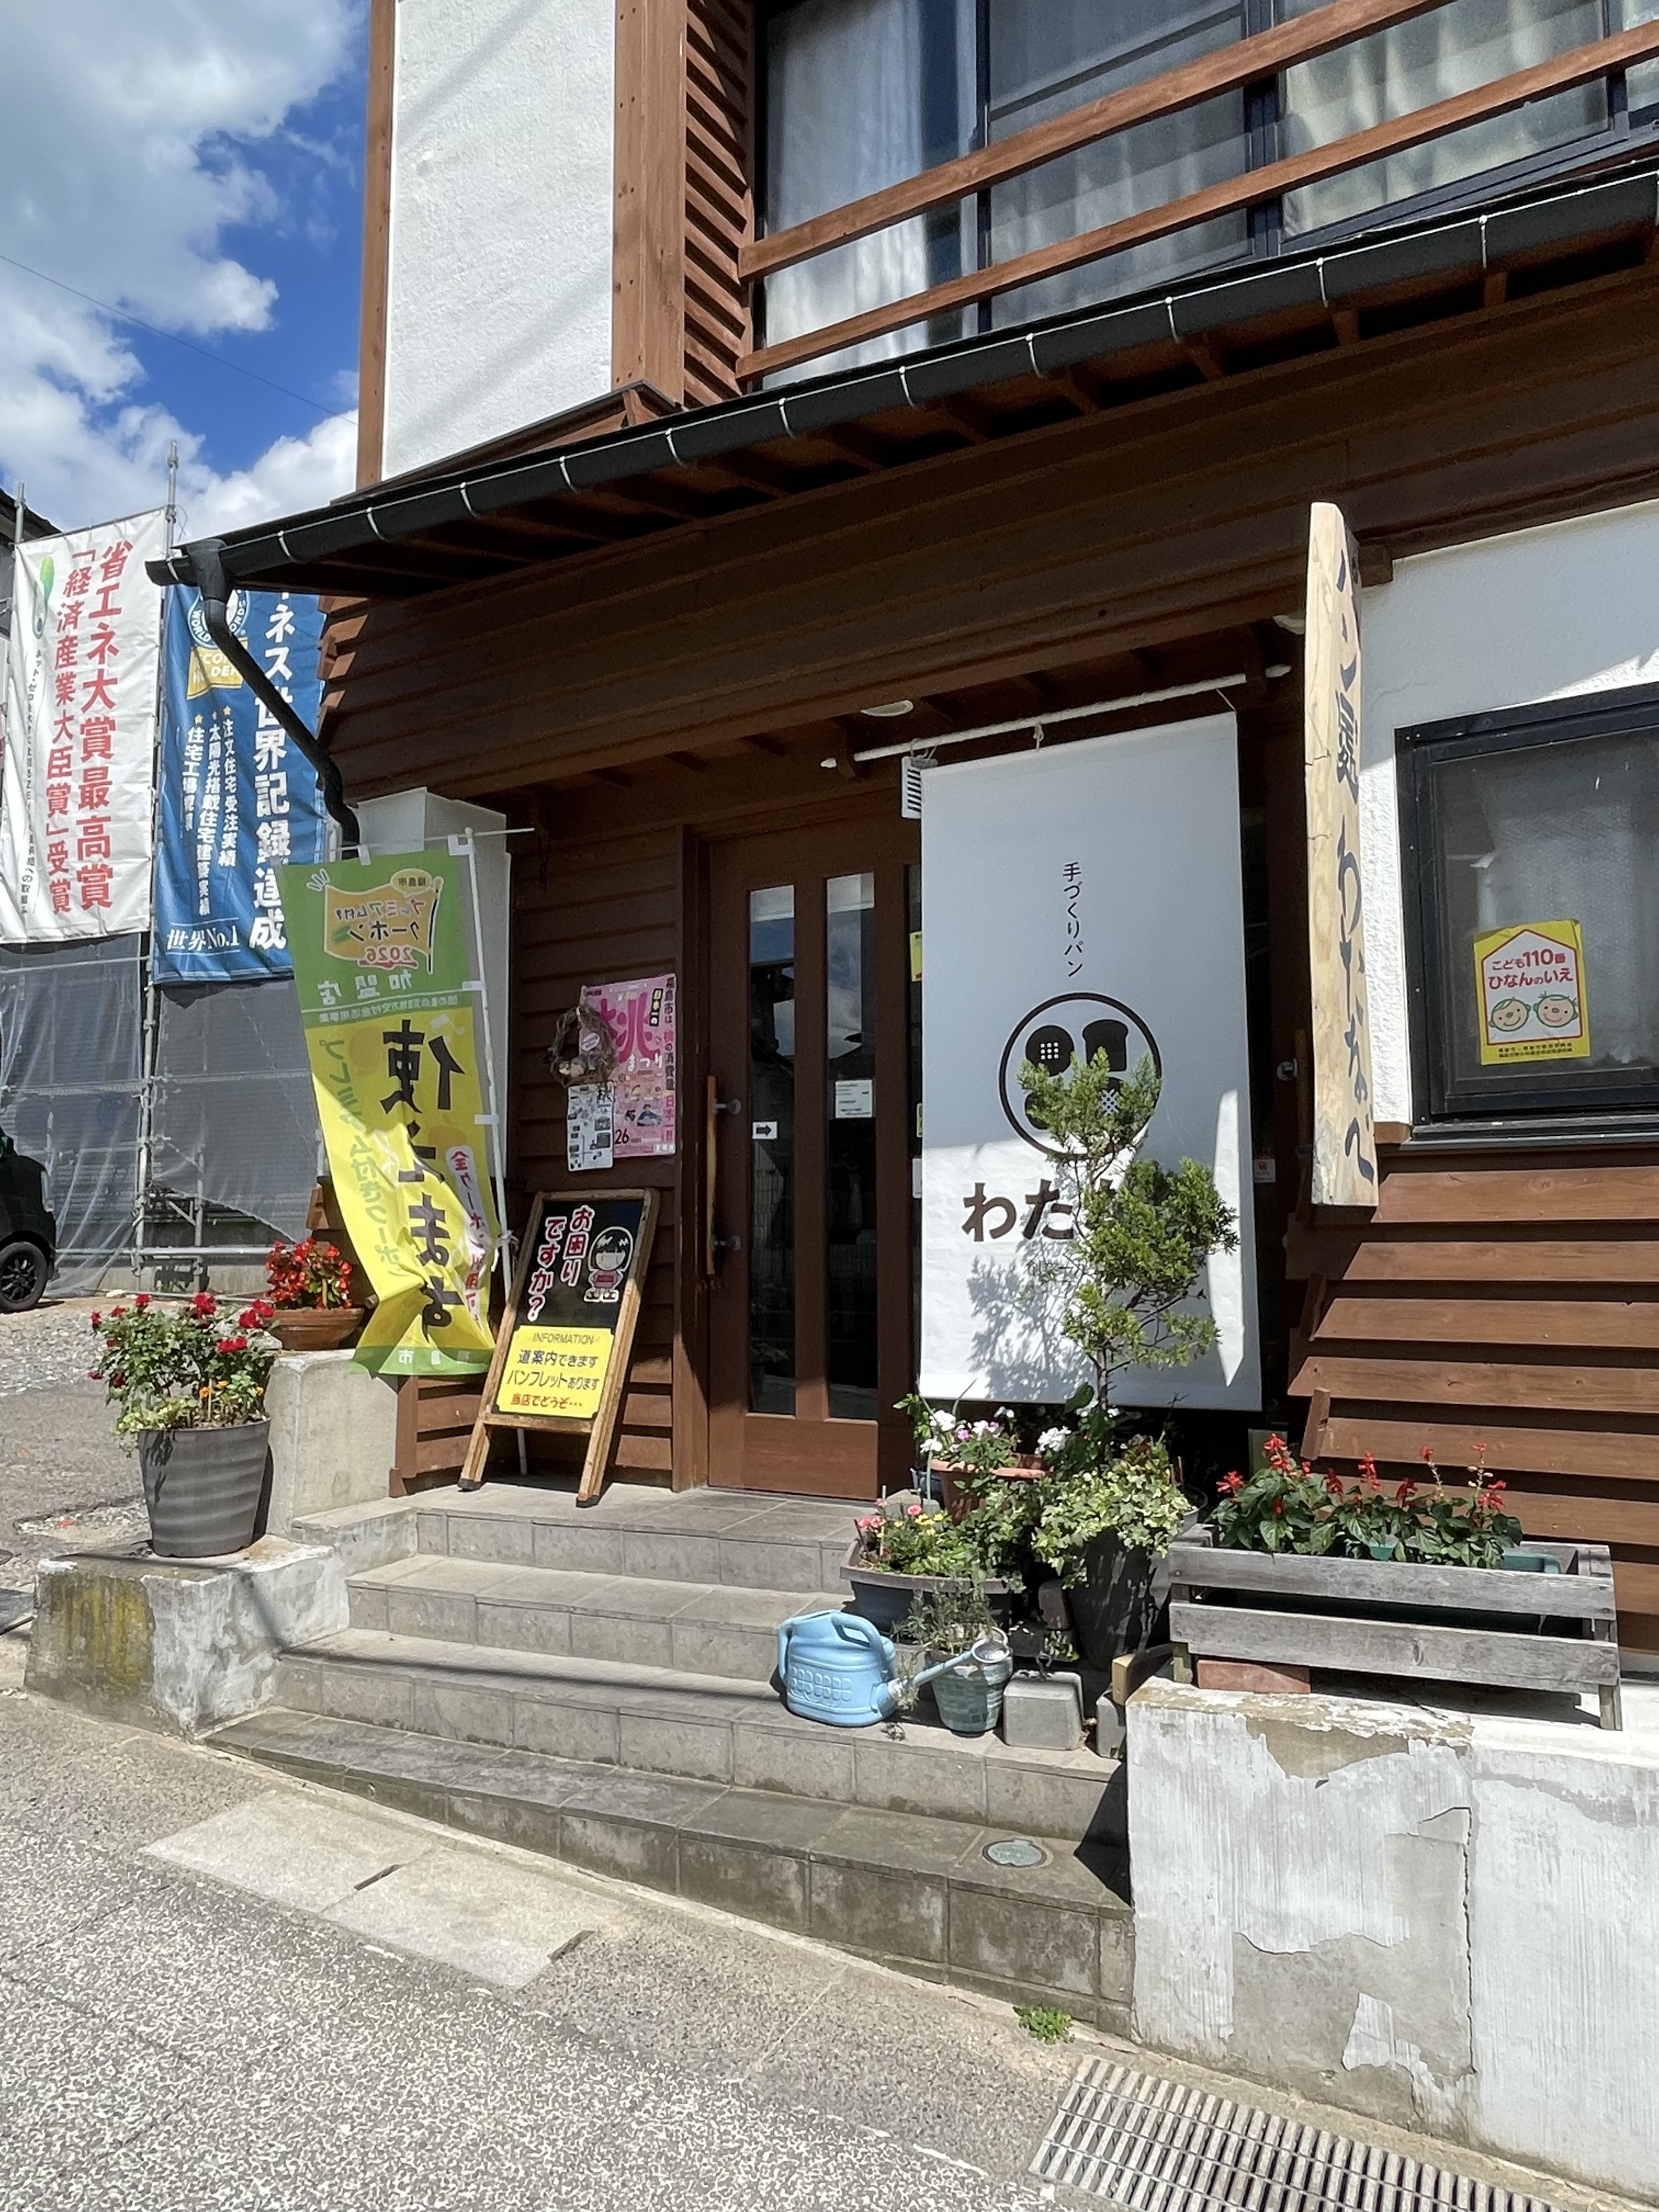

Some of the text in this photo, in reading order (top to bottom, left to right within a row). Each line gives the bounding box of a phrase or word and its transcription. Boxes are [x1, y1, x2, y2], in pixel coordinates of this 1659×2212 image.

[191, 610, 212, 642] WORLD
[46, 549, 96, 914] 「経済産業大臣賞」受賞
[76, 540, 134, 910] 省エネ大賞最高賞
[249, 592, 296, 949] ネス世界記録達成
[166, 926, 240, 951] 世界No.1
[1063, 861, 1084, 978] 手づくりパン
[1489, 968, 1573, 989] ひなんのいえ
[961, 1178, 1116, 1242] わた
[528, 1216, 567, 1321] ですか?
[561, 1205, 594, 1286] お困り
[517, 1349, 599, 1368] 道案内できます
[533, 1332, 595, 1344] INFORMATION
[507, 1369, 600, 1391] パンフレットあります
